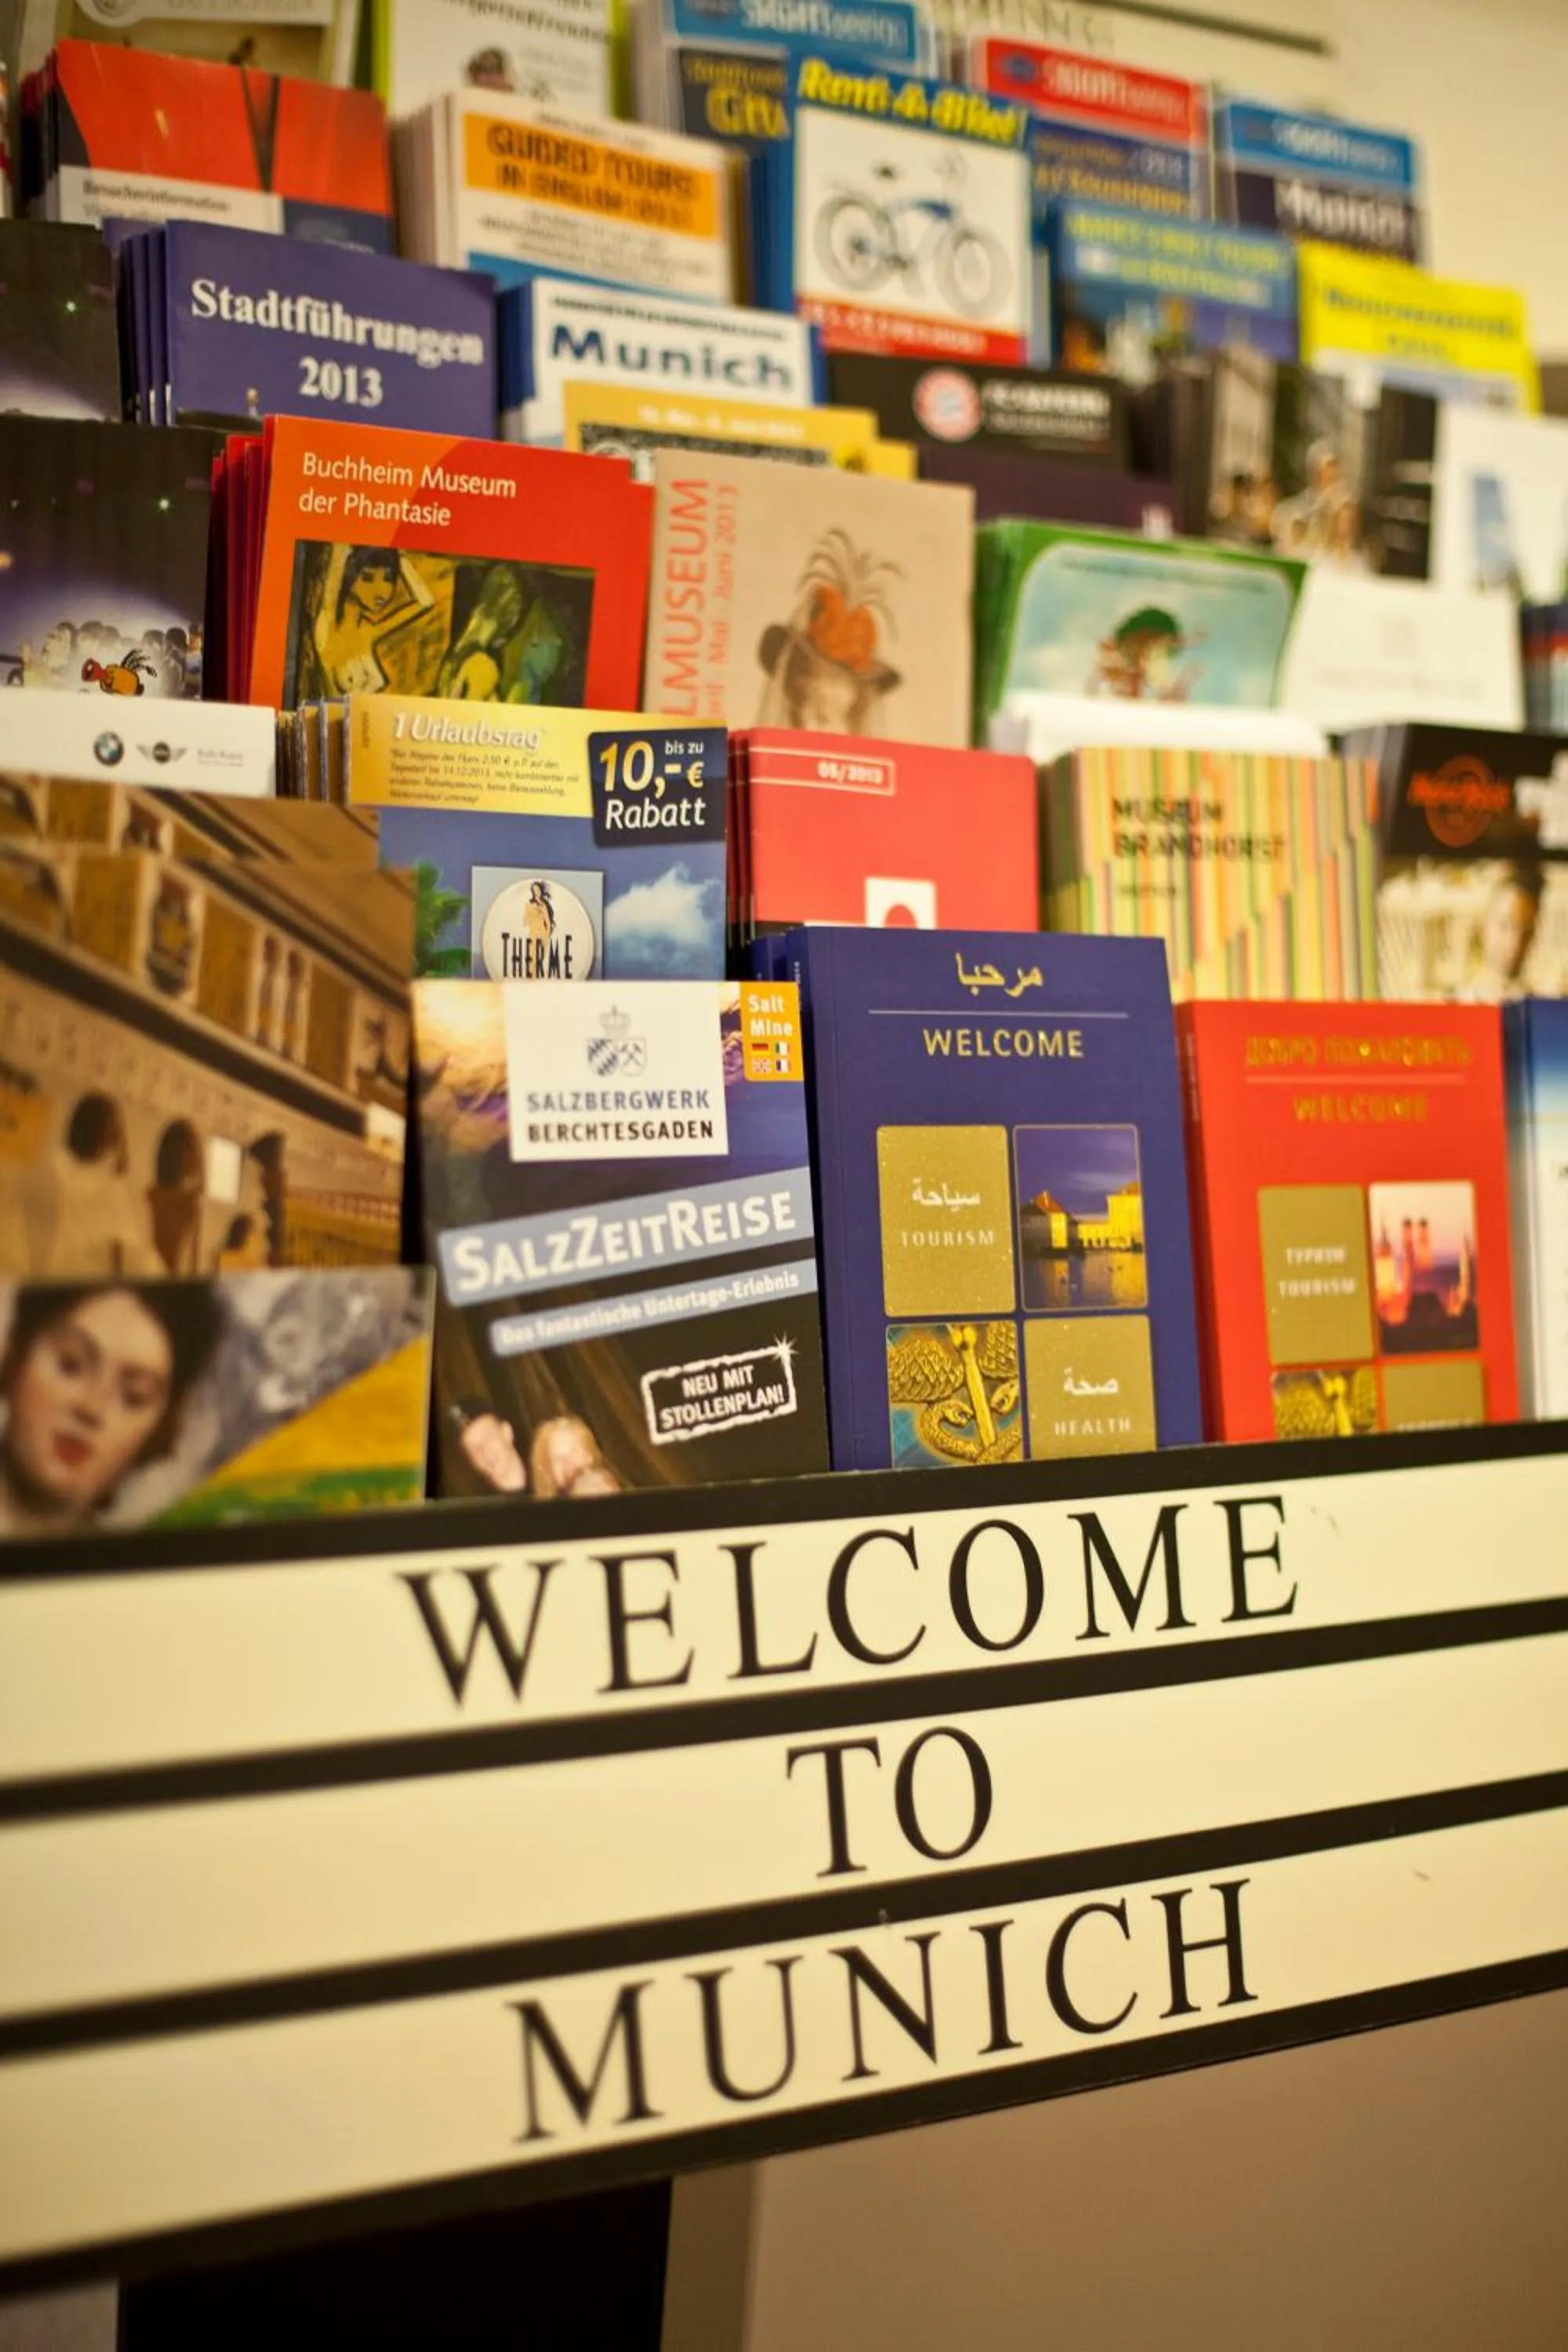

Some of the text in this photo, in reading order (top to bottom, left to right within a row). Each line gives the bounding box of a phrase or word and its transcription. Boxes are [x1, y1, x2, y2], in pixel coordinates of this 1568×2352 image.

[191, 278, 485, 369] Stadtführungen
[551, 324, 793, 393] Munich
[299, 358, 383, 408] 2013
[303, 452, 517, 499] Buchheim Museum
[299, 487, 451, 527] der Phantasie
[714, 485, 738, 545] 2013
[711, 552, 733, 600] Juni
[394, 713, 406, 739] 1
[665, 741, 704, 755] bis zu
[605, 797, 706, 830] Rabatt
[1112, 797, 1222, 824] MUSEUM
[501, 932, 573, 979] THERME
[955, 952, 1044, 998] مرحبا
[748, 994, 785, 1013] Salt
[750, 1018, 793, 1036] Mine
[923, 1028, 1083, 1058] WELCOME
[526, 1088, 711, 1112] SALZBERGWERK
[1293, 1094, 1427, 1123] WELCOME
[528, 1120, 713, 1143] BERCHTESGADEN
[912, 1178, 980, 1213] سياحة
[902, 1229, 994, 1247] TOURISM
[1279, 1276, 1356, 1298] TOURISM
[502, 1269, 800, 1344] Das fantastische Untertage-Erlebnis
[682, 1364, 755, 1398] NEU MIT
[1064, 1367, 1119, 1396] صحة
[659, 1385, 785, 1431] STOLLENPLAN!
[1054, 1417, 1131, 1436] HEALTH
[397, 1496, 1299, 1708] WELCOME
[785, 1724, 993, 1878] TO
[508, 1877, 1259, 2144] MUNICH
